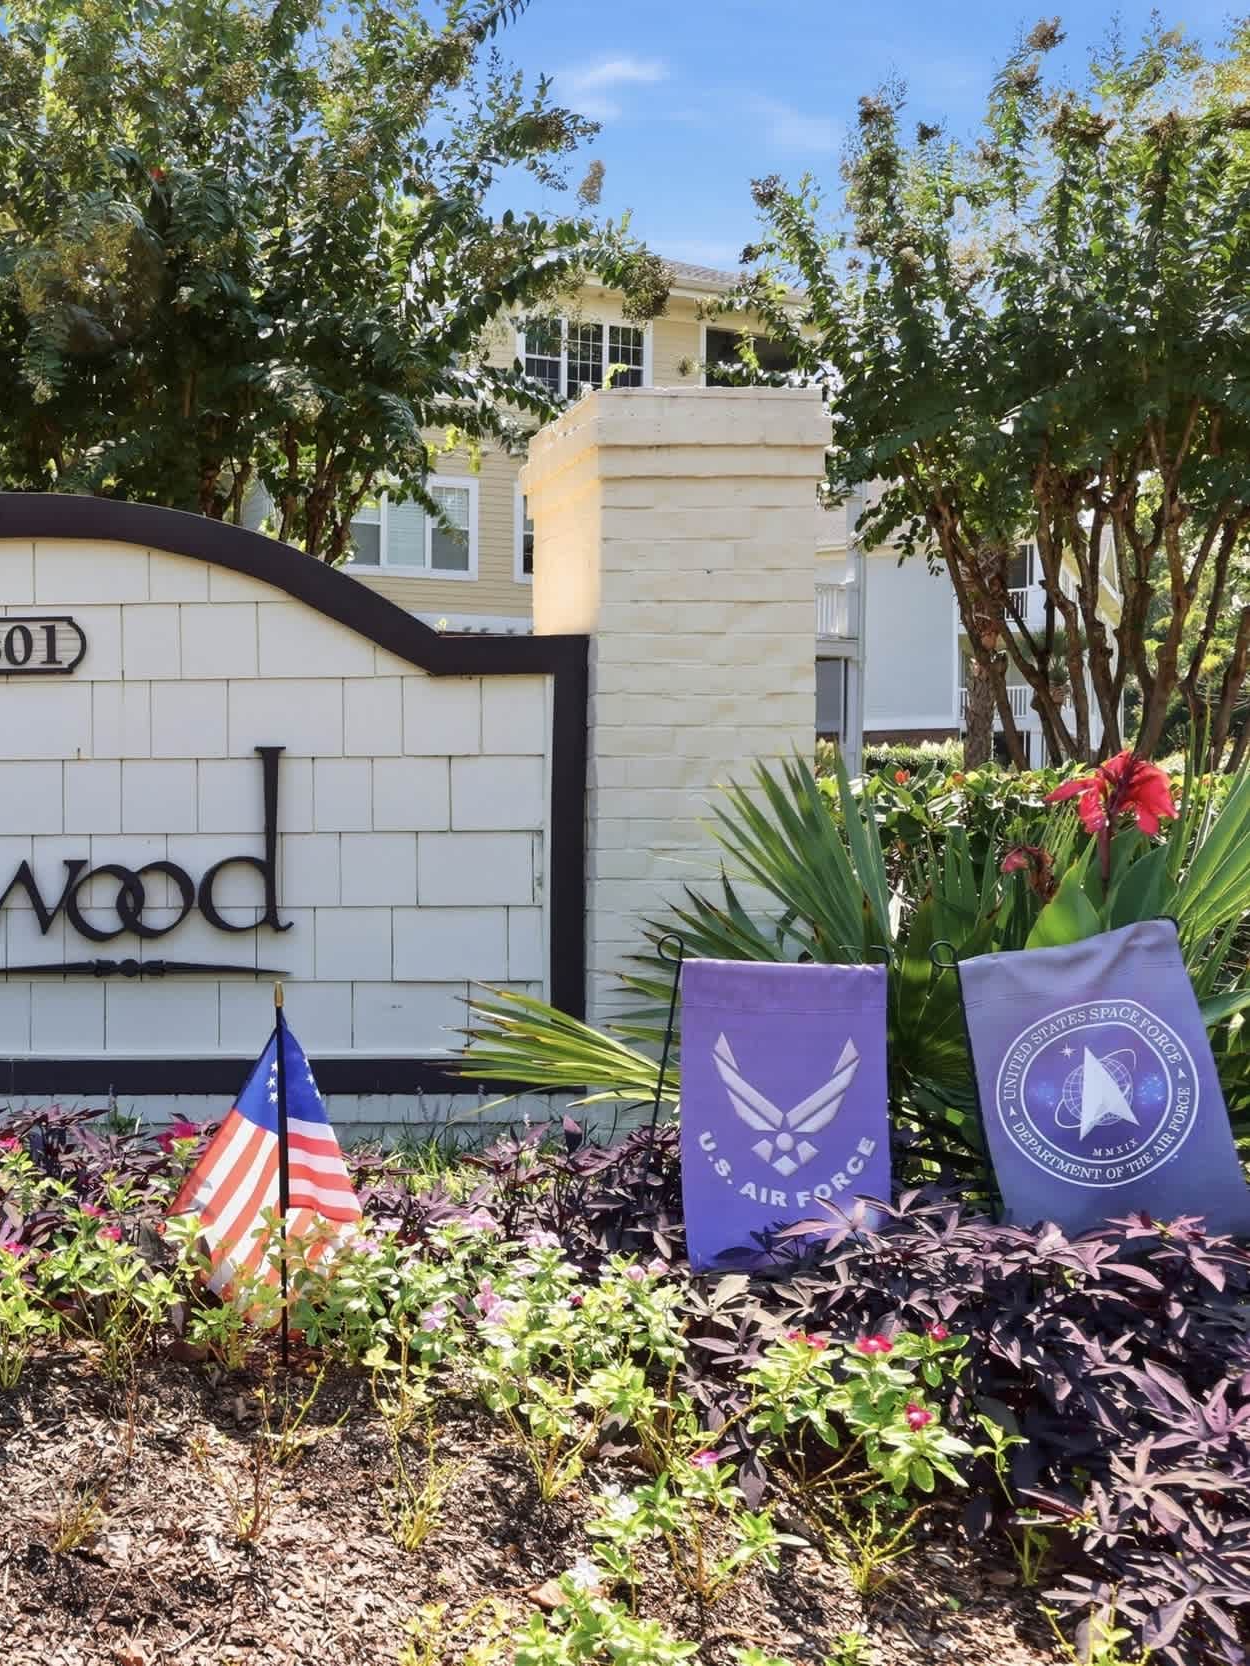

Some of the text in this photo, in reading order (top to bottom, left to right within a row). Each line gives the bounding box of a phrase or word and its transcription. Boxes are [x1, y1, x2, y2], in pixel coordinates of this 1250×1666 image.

[1004, 1006, 1183, 1101] UNITED STATES SPACE FORCE
[698, 1131, 878, 1209] U.S. AIR FORCE
[1012, 1086, 1191, 1180] DEPARTMENT OF THE AIR FORCE
